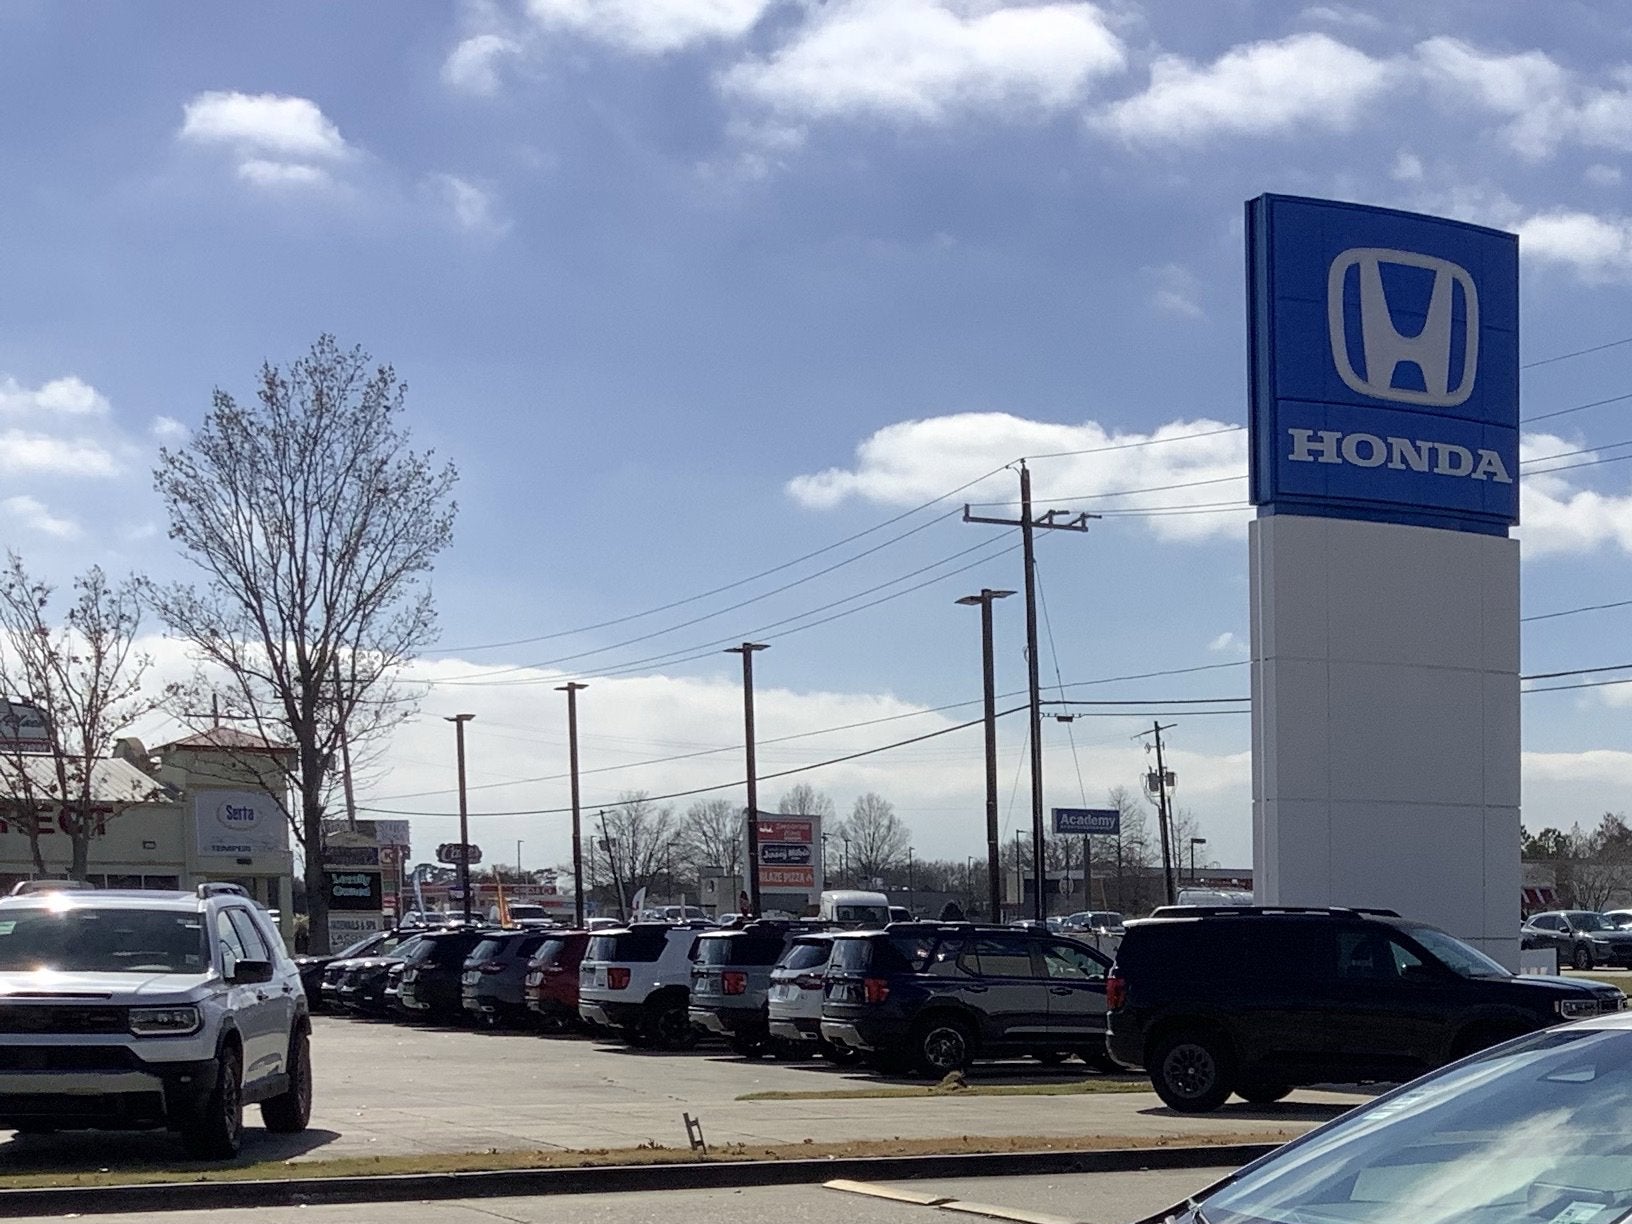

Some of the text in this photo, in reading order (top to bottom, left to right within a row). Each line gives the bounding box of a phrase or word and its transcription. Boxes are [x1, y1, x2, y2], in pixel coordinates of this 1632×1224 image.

[1288, 428, 1513, 484] HONDA
[225, 804, 255, 821] Serta
[1059, 812, 1116, 829] Academy
